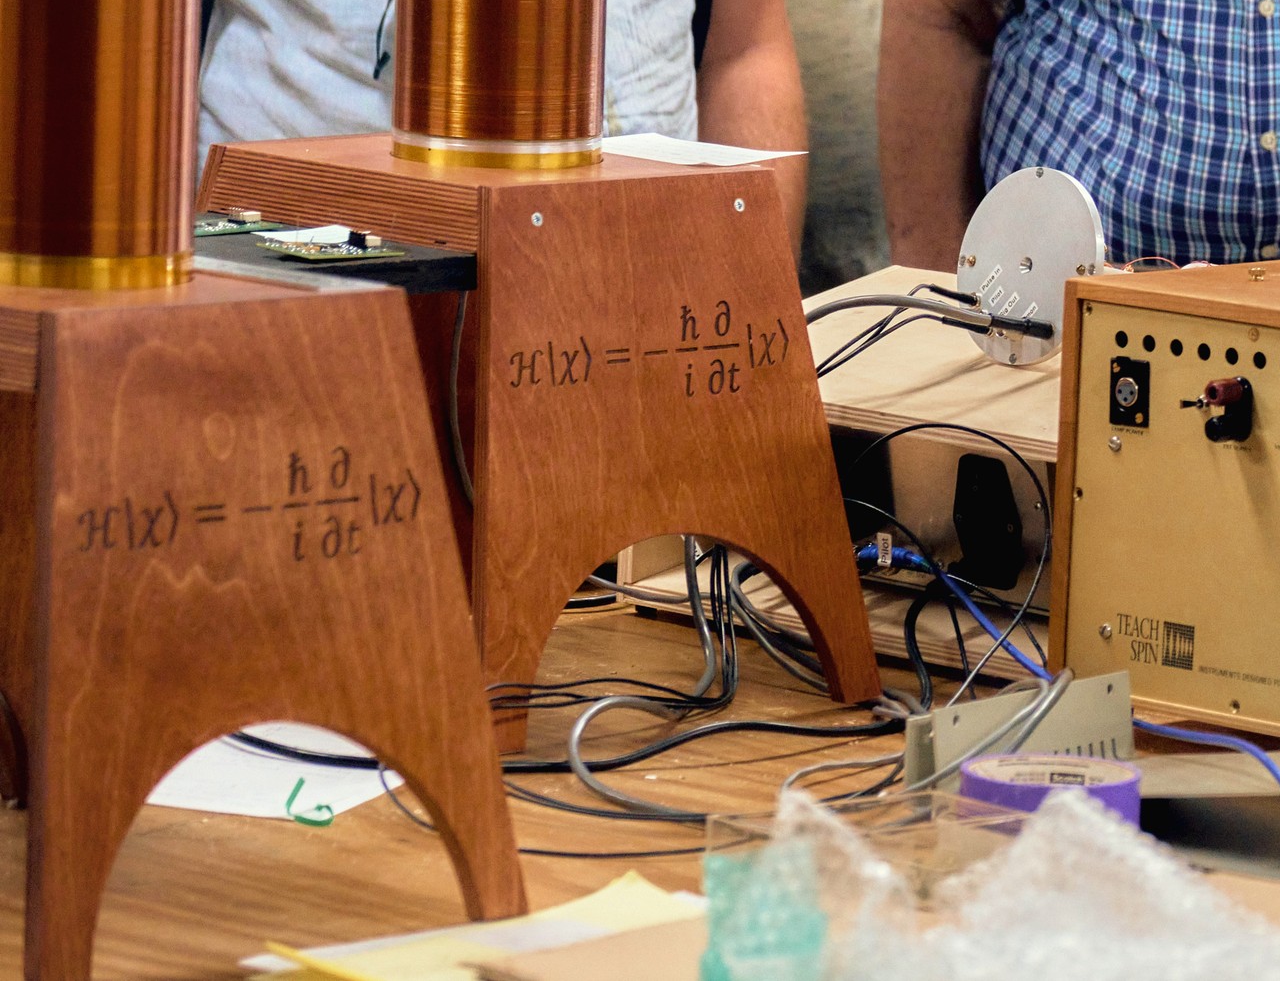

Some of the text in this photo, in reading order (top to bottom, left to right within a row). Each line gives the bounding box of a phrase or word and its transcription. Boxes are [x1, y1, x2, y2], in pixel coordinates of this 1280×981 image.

[990, 289, 1003, 304] Pilot
[1008, 296, 1018, 308] Out
[880, 537, 889, 564] Pilot
[1116, 612, 1160, 642] TEACH
[1130, 639, 1159, 665] SPIN
[1198, 665, 1241, 681] INSTRUMENTS
